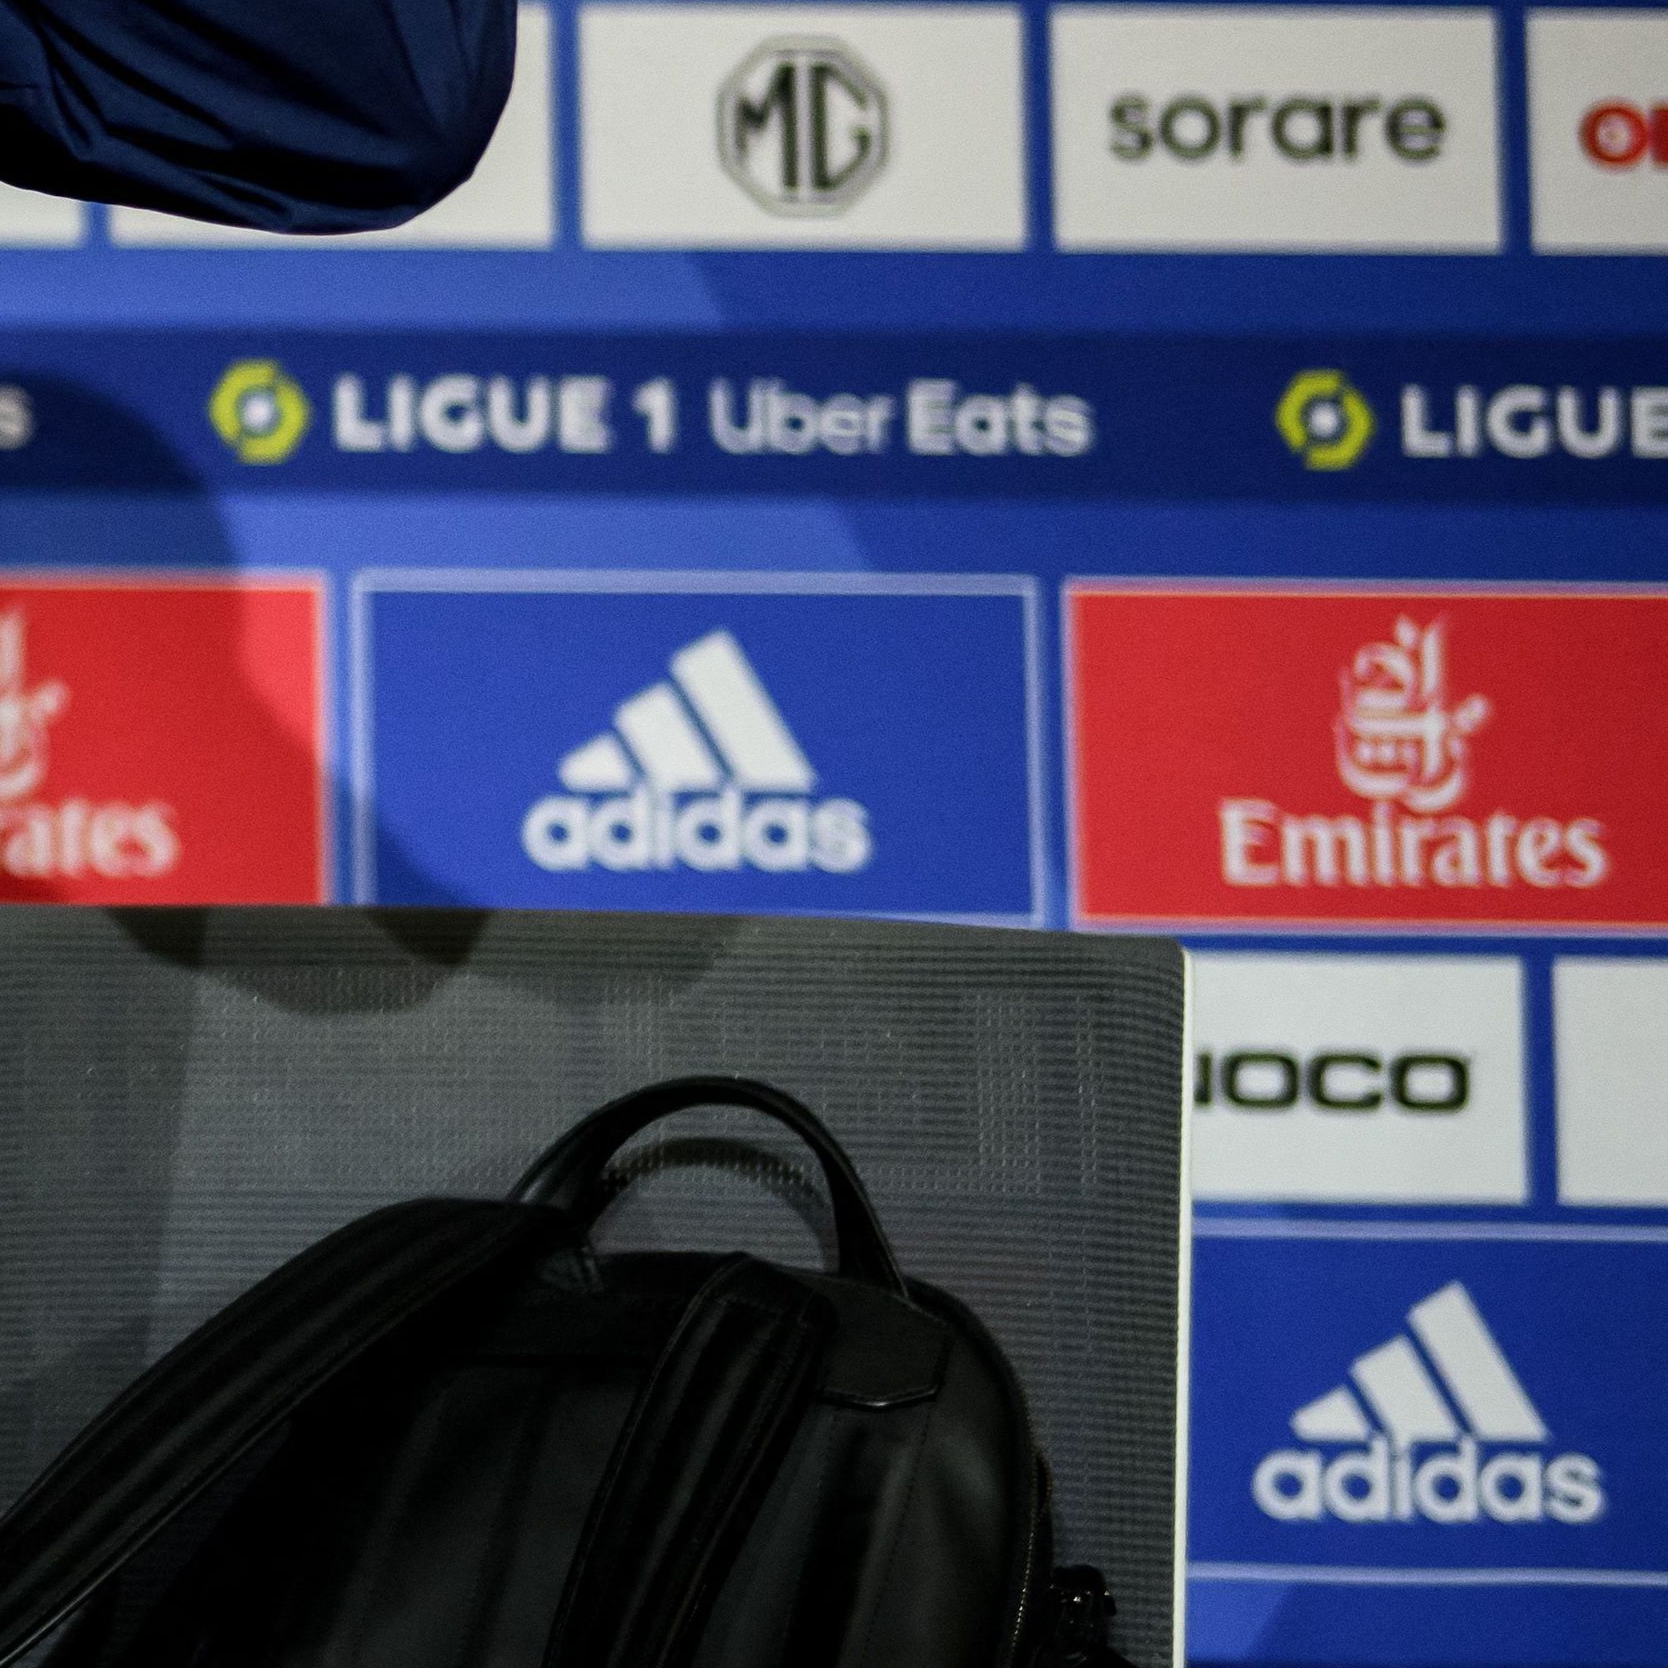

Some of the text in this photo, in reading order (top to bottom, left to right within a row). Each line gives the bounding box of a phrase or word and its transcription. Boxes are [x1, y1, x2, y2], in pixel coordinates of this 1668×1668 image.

[724, 46, 884, 207] MG
[1108, 92, 1451, 165] sorare
[332, 374, 1094, 457] LIGUE 1 Uber Eats
[1400, 384, 1668, 459] LIGUE
[520, 784, 873, 873] adidas
[1217, 796, 1610, 889] Emirates
[1250, 1431, 1606, 1525] adidas
